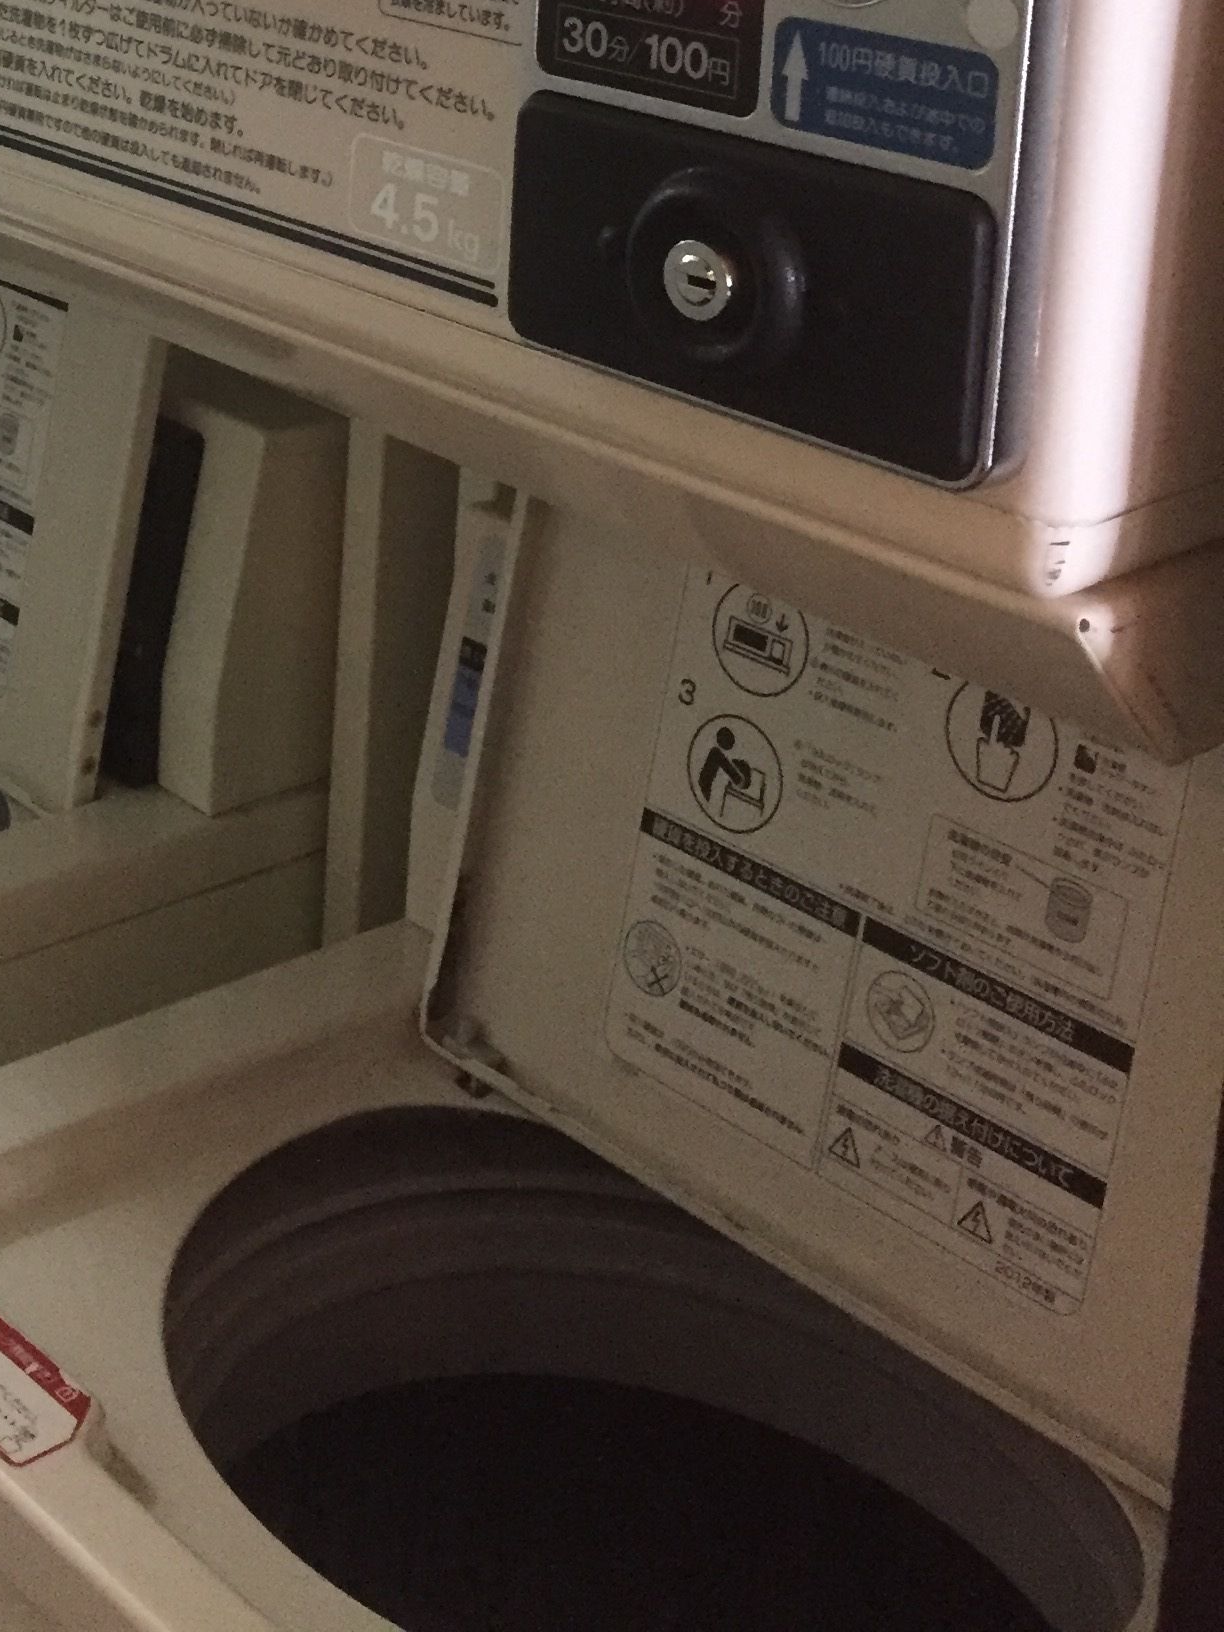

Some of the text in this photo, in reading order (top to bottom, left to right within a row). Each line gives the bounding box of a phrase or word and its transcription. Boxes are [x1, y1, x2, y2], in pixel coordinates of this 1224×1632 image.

[719, 0, 743, 29] 分
[561, 16, 732, 86] 30分/100円
[817, 41, 990, 98] 100円硬貨投入口
[370, 182, 478, 255] 4.5 kg
[678, 677, 697, 706] 3
